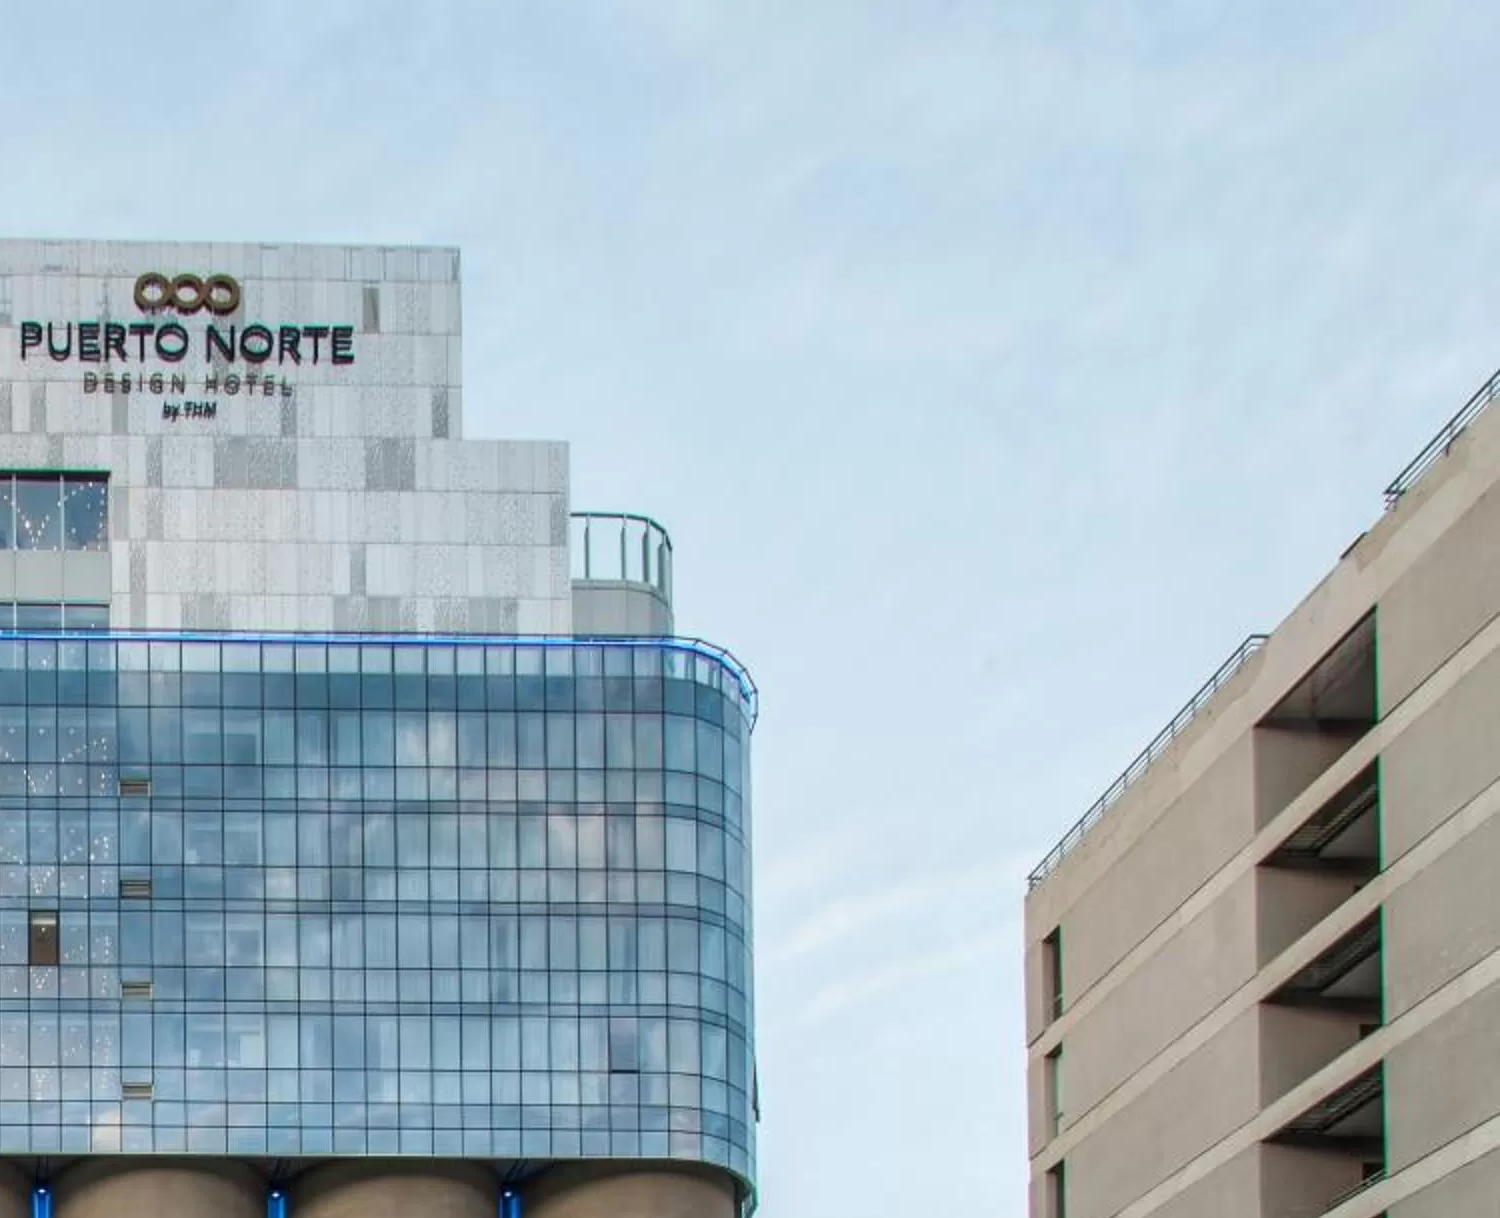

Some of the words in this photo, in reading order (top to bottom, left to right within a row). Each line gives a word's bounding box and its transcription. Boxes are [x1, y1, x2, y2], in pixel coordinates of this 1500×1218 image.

[20, 321, 190, 362] PUERTO
[205, 324, 356, 366] NORTE
[84, 371, 186, 394] DESIGN
[205, 373, 294, 397] HOTEL
[162, 402, 181, 421] by
